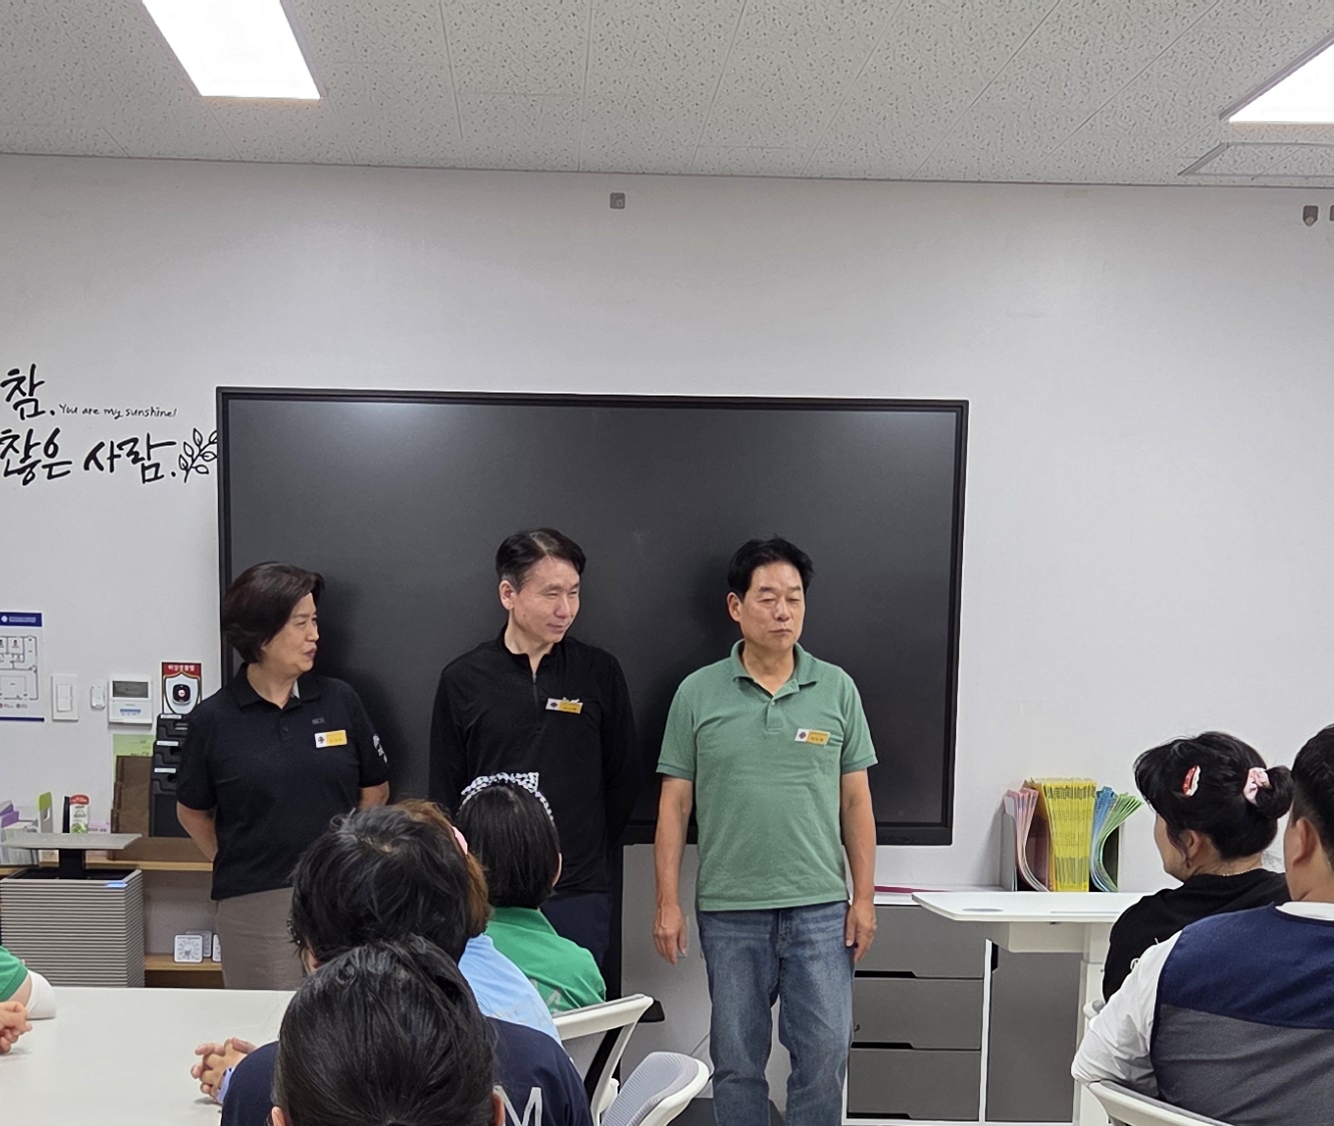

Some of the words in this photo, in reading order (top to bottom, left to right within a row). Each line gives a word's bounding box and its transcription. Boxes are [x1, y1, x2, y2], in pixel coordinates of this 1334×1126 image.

[0, 363, 55, 420] 참.
[58, 403, 78, 414] You
[82, 407, 100, 415] are
[103, 408, 123, 420] my
[83, 433, 178, 484] 사람.
